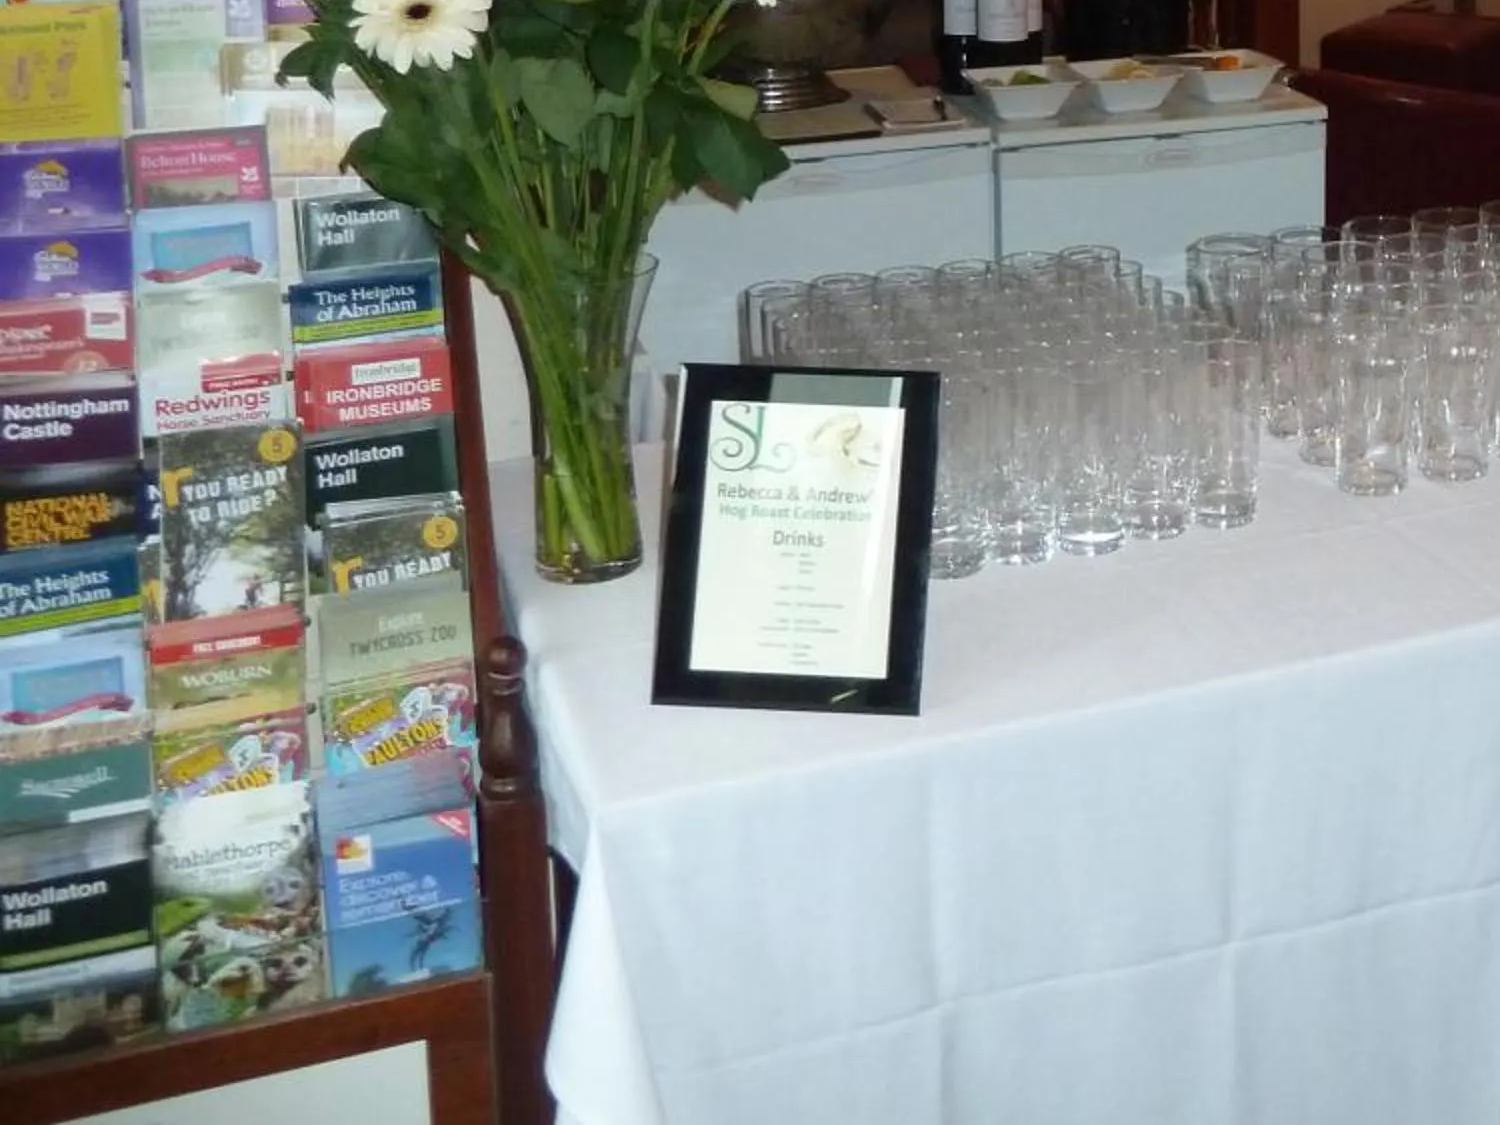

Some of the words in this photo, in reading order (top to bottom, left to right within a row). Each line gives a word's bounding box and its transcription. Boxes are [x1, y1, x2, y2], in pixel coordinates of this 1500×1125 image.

[315, 208, 401, 227] Wollaton
[317, 229, 355, 247] Hall
[314, 291, 347, 305] The
[351, 284, 416, 303] Heights
[316, 304, 334, 322] of
[338, 298, 418, 319] Abraham
[155, 391, 271, 417] Redwings
[325, 379, 443, 405] IRONBRIDGE
[3, 398, 130, 421] Nottingham
[202, 409, 271, 425] Sanctuary
[339, 397, 433, 422] MUSEUMS
[3, 420, 74, 441] Castle
[315, 444, 405, 470] Wollaton
[182, 480, 222, 502] YOU
[226, 465, 288, 492] READY
[318, 468, 358, 489] Hall
[6, 492, 109, 518] NATIONAL
[717, 483, 783, 501] Rebecca
[786, 486, 801, 501] &
[805, 488, 876, 505] Andrew
[187, 506, 211, 530] TO
[216, 488, 277, 520] RIDE?
[719, 503, 747, 520] Hog
[751, 506, 790, 519] Roast
[793, 506, 872, 523] Celebration
[6, 526, 93, 550] CENTRE
[434, 524, 447, 540] 5
[772, 530, 825, 548] Drinks
[352, 568, 391, 588] YOU
[394, 551, 451, 580] READY
[34, 571, 111, 594] Heights
[20, 588, 113, 615] Abraham
[350, 629, 427, 658] TWYCROSS
[430, 625, 458, 643] ZOO
[181, 665, 273, 689] WOBURN
[2, 879, 109, 910] Wollaton
[3, 908, 51, 931] Hall
